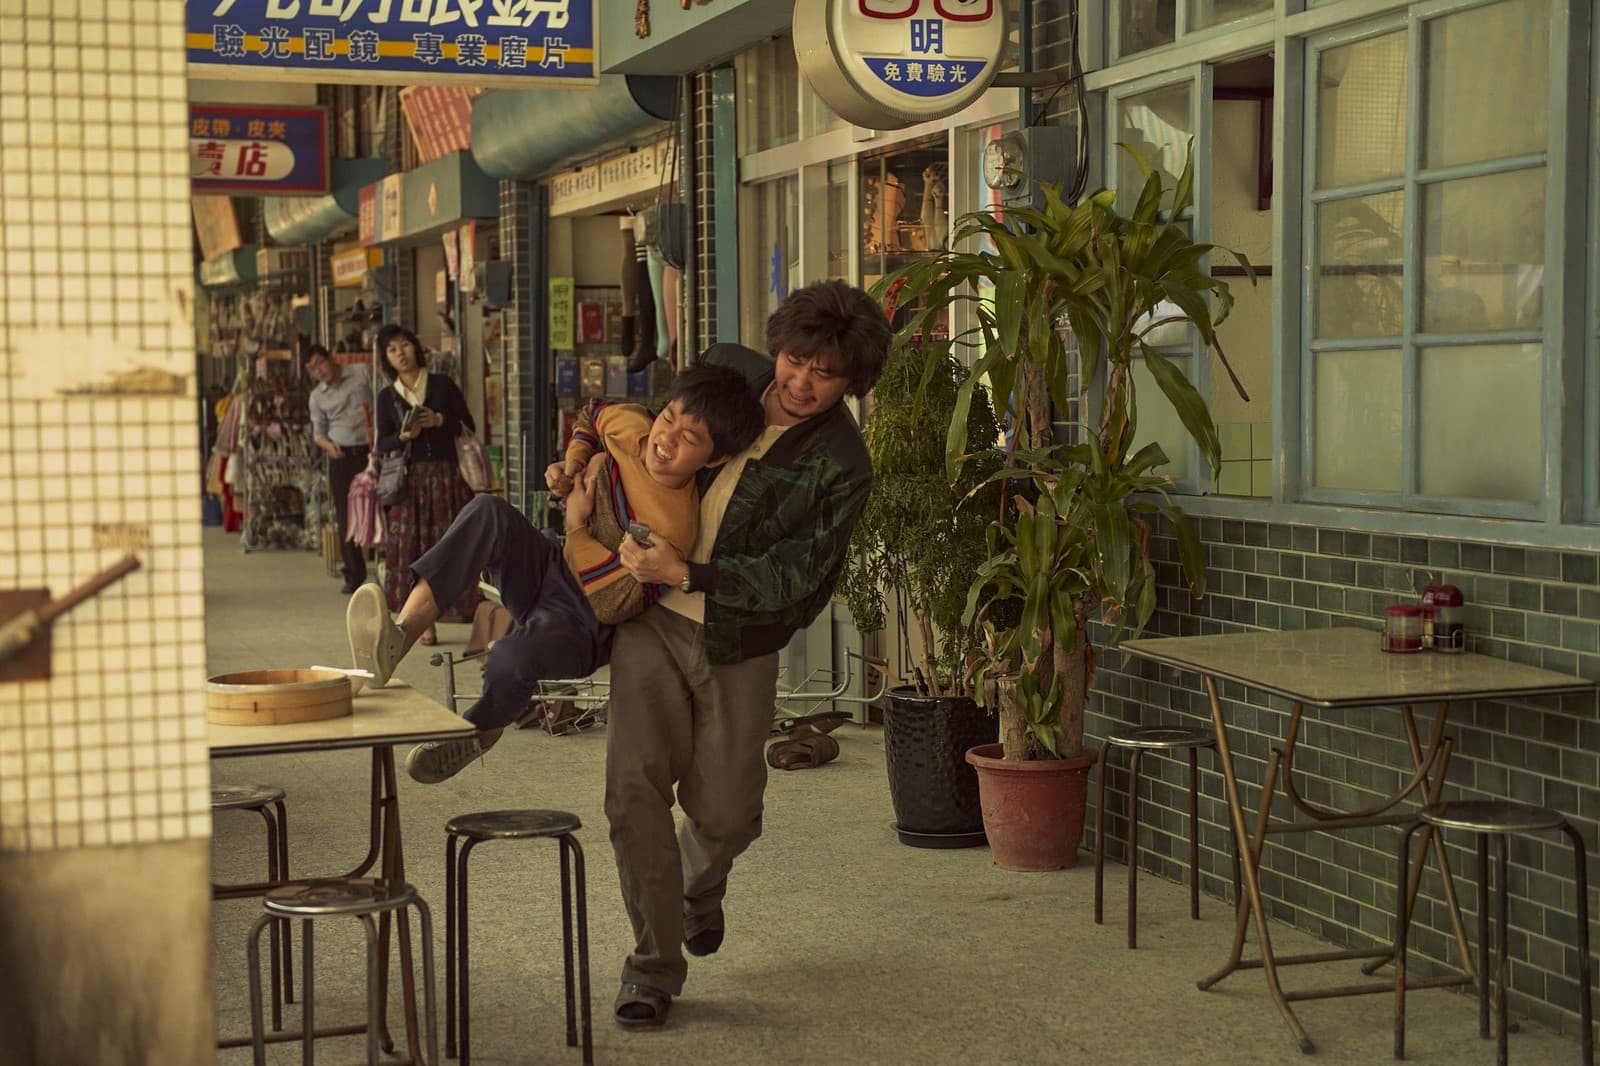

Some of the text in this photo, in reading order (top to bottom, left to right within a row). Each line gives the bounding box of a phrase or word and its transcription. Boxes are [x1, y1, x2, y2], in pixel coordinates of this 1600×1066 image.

[213, 24, 571, 69] 驗光配鏡 專業磨片
[910, 19, 944, 54] 明
[883, 62, 967, 83] 免費驗光
